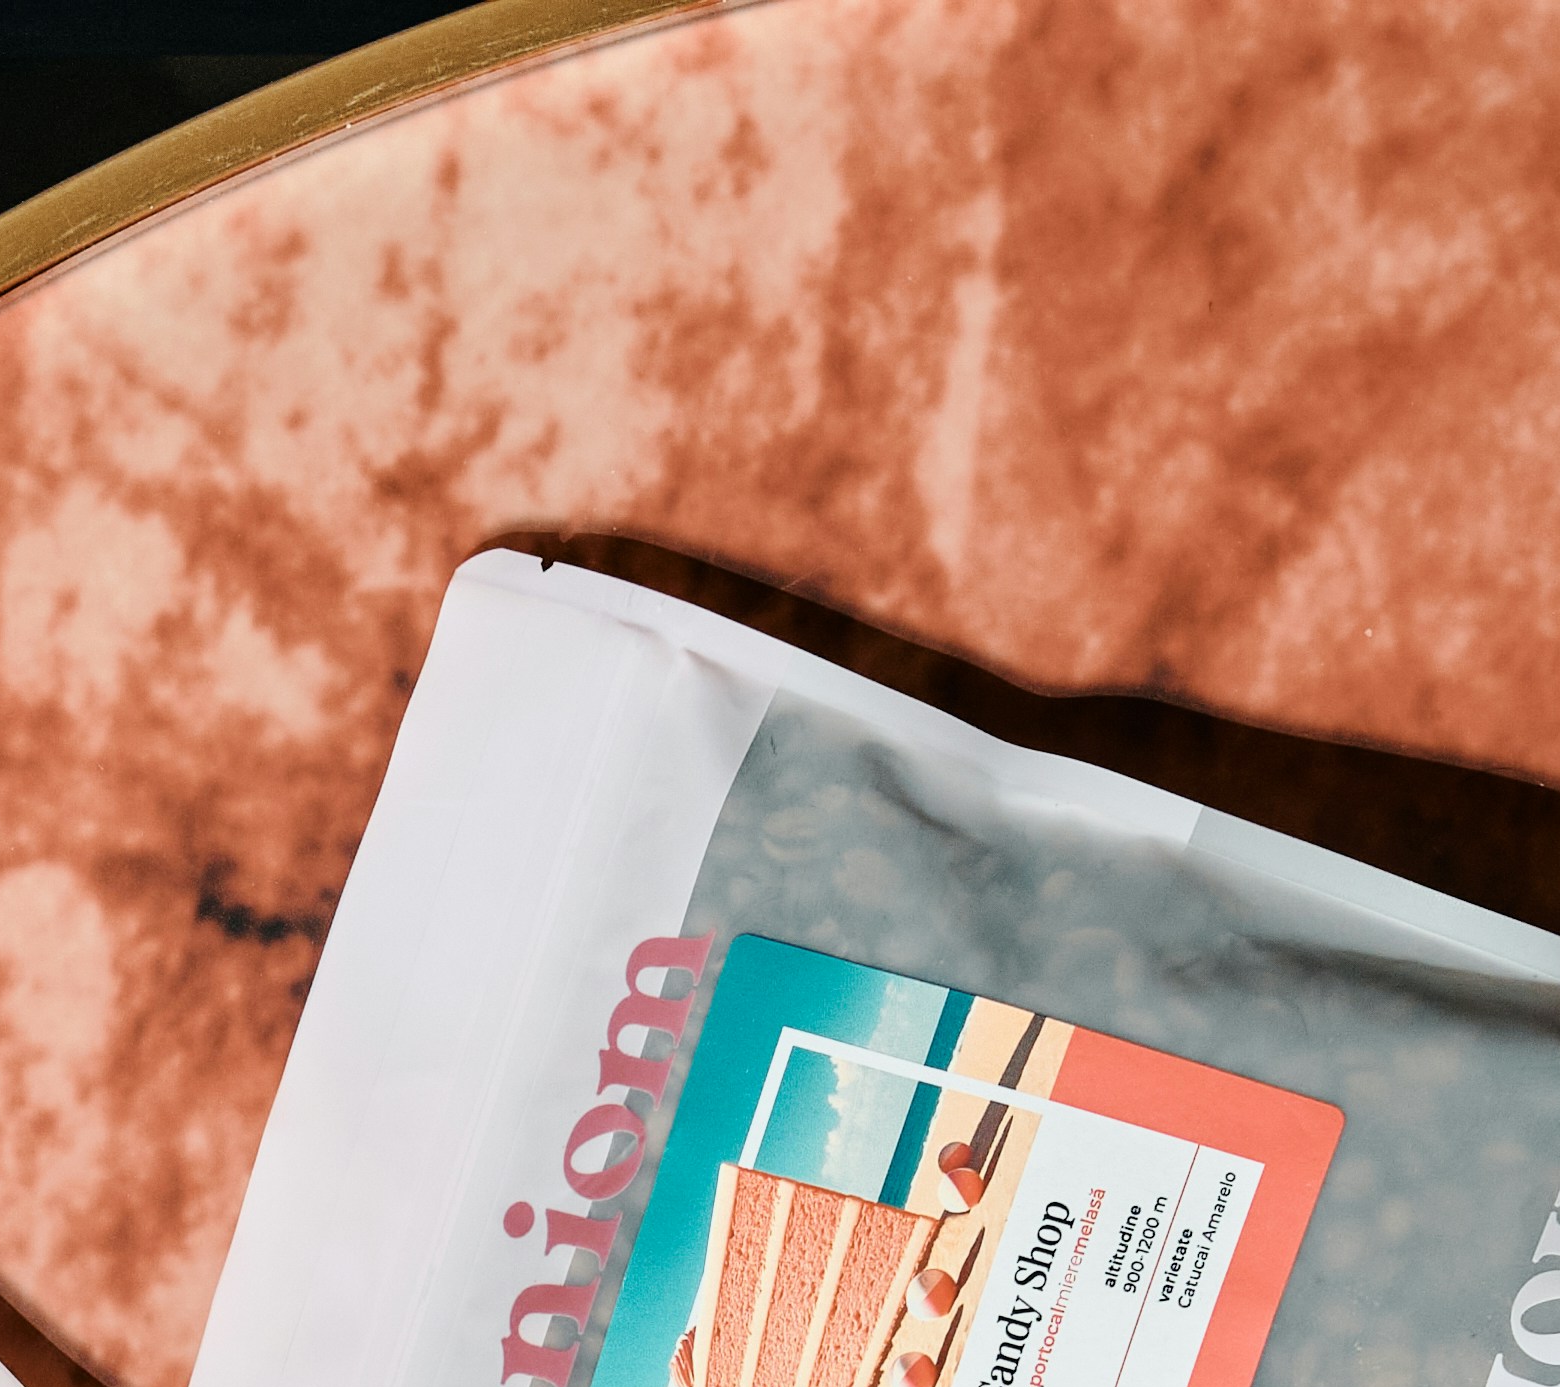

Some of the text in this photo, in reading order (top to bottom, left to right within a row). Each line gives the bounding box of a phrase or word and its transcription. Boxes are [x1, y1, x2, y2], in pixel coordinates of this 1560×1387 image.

[1014, 1202, 1075, 1291] Shop
[1105, 1205, 1141, 1288] altitudine
[1123, 1197, 1168, 1293] 900-1200 m
[1158, 1229, 1193, 1302] varietate
[1178, 1172, 1236, 1308] Catucai Amarelo
